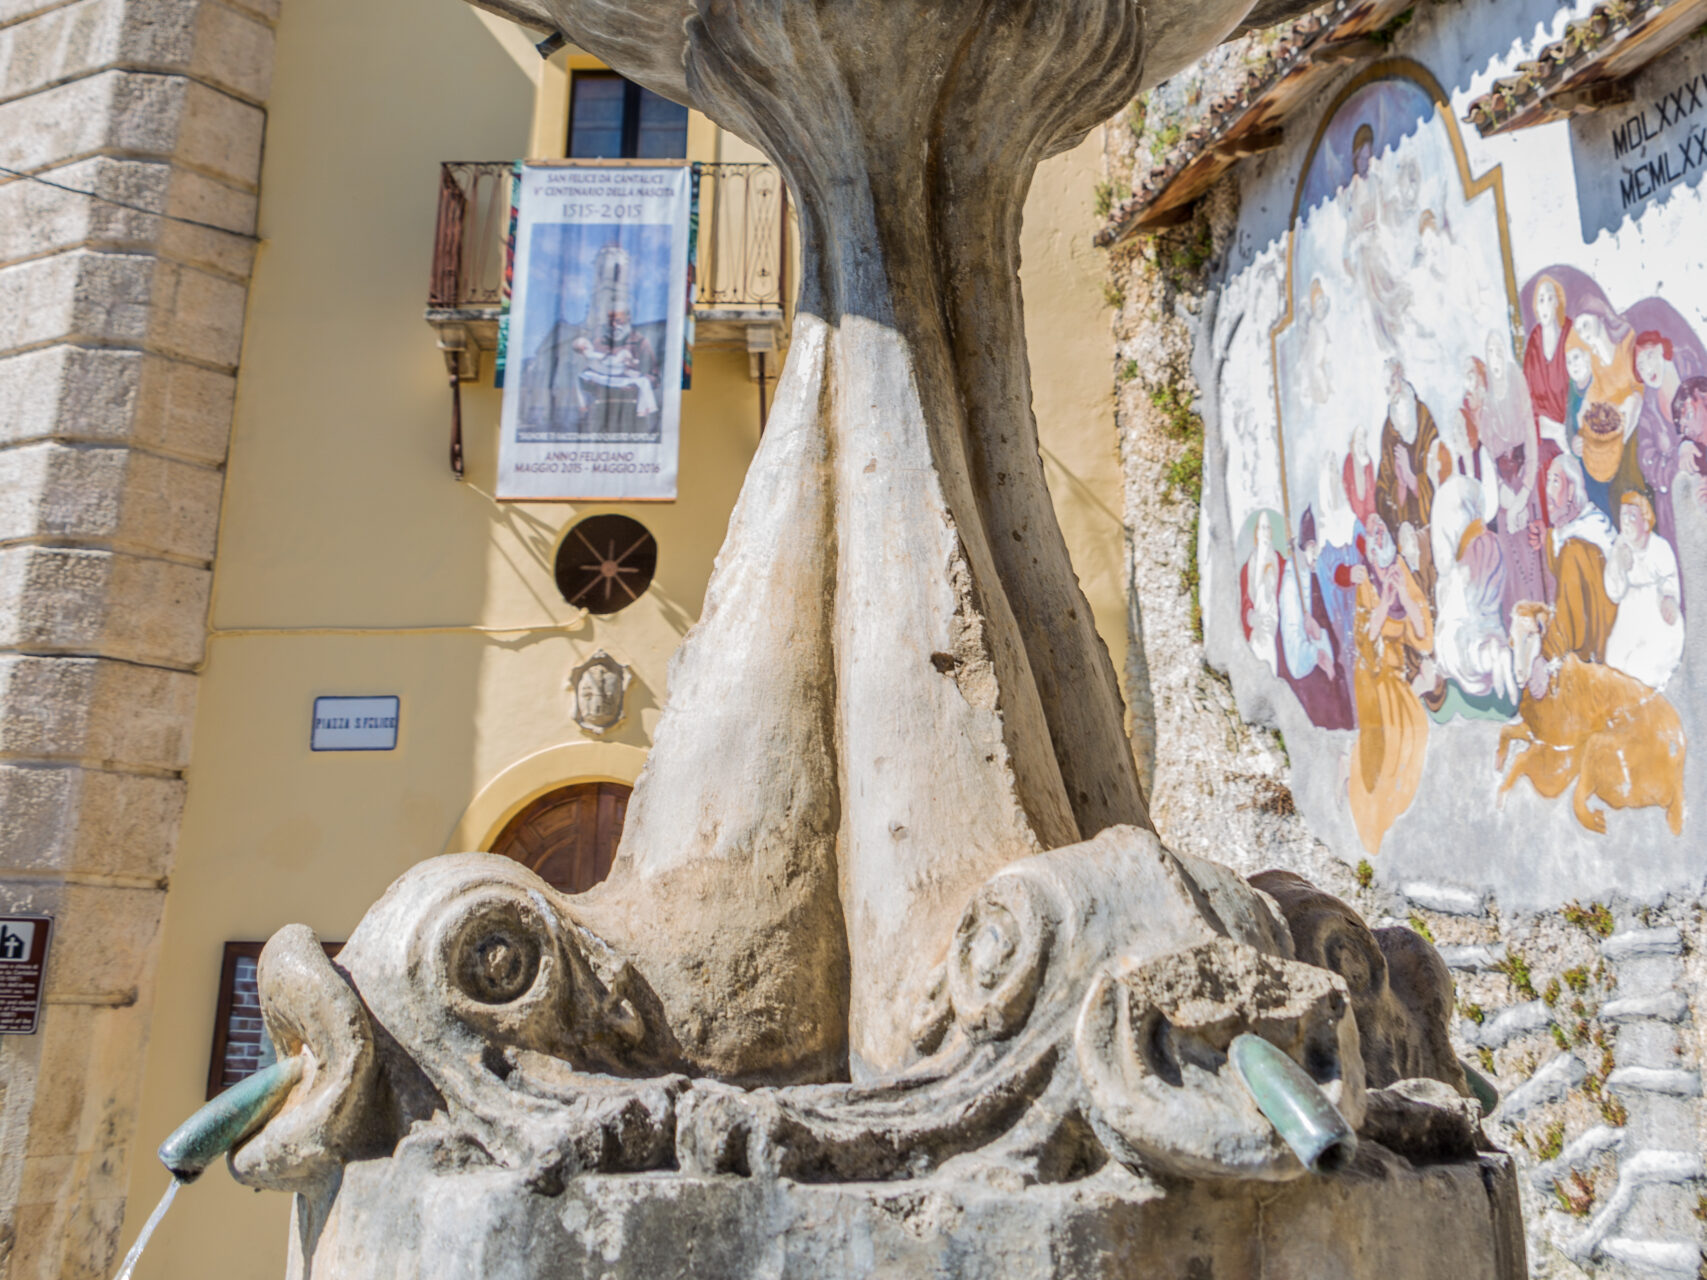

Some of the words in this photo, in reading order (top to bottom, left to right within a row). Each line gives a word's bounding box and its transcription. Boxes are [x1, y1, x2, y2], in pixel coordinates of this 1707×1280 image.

[545, 186, 605, 197] CENTENARIO
[605, 186, 634, 197] DELLA
[545, 451, 578, 462] ANNO
[579, 451, 635, 462] FELICIANO
[514, 463, 559, 474] MAGGIO
[591, 463, 637, 474] MAGGIO
[315, 717, 350, 729] PIAZZA
